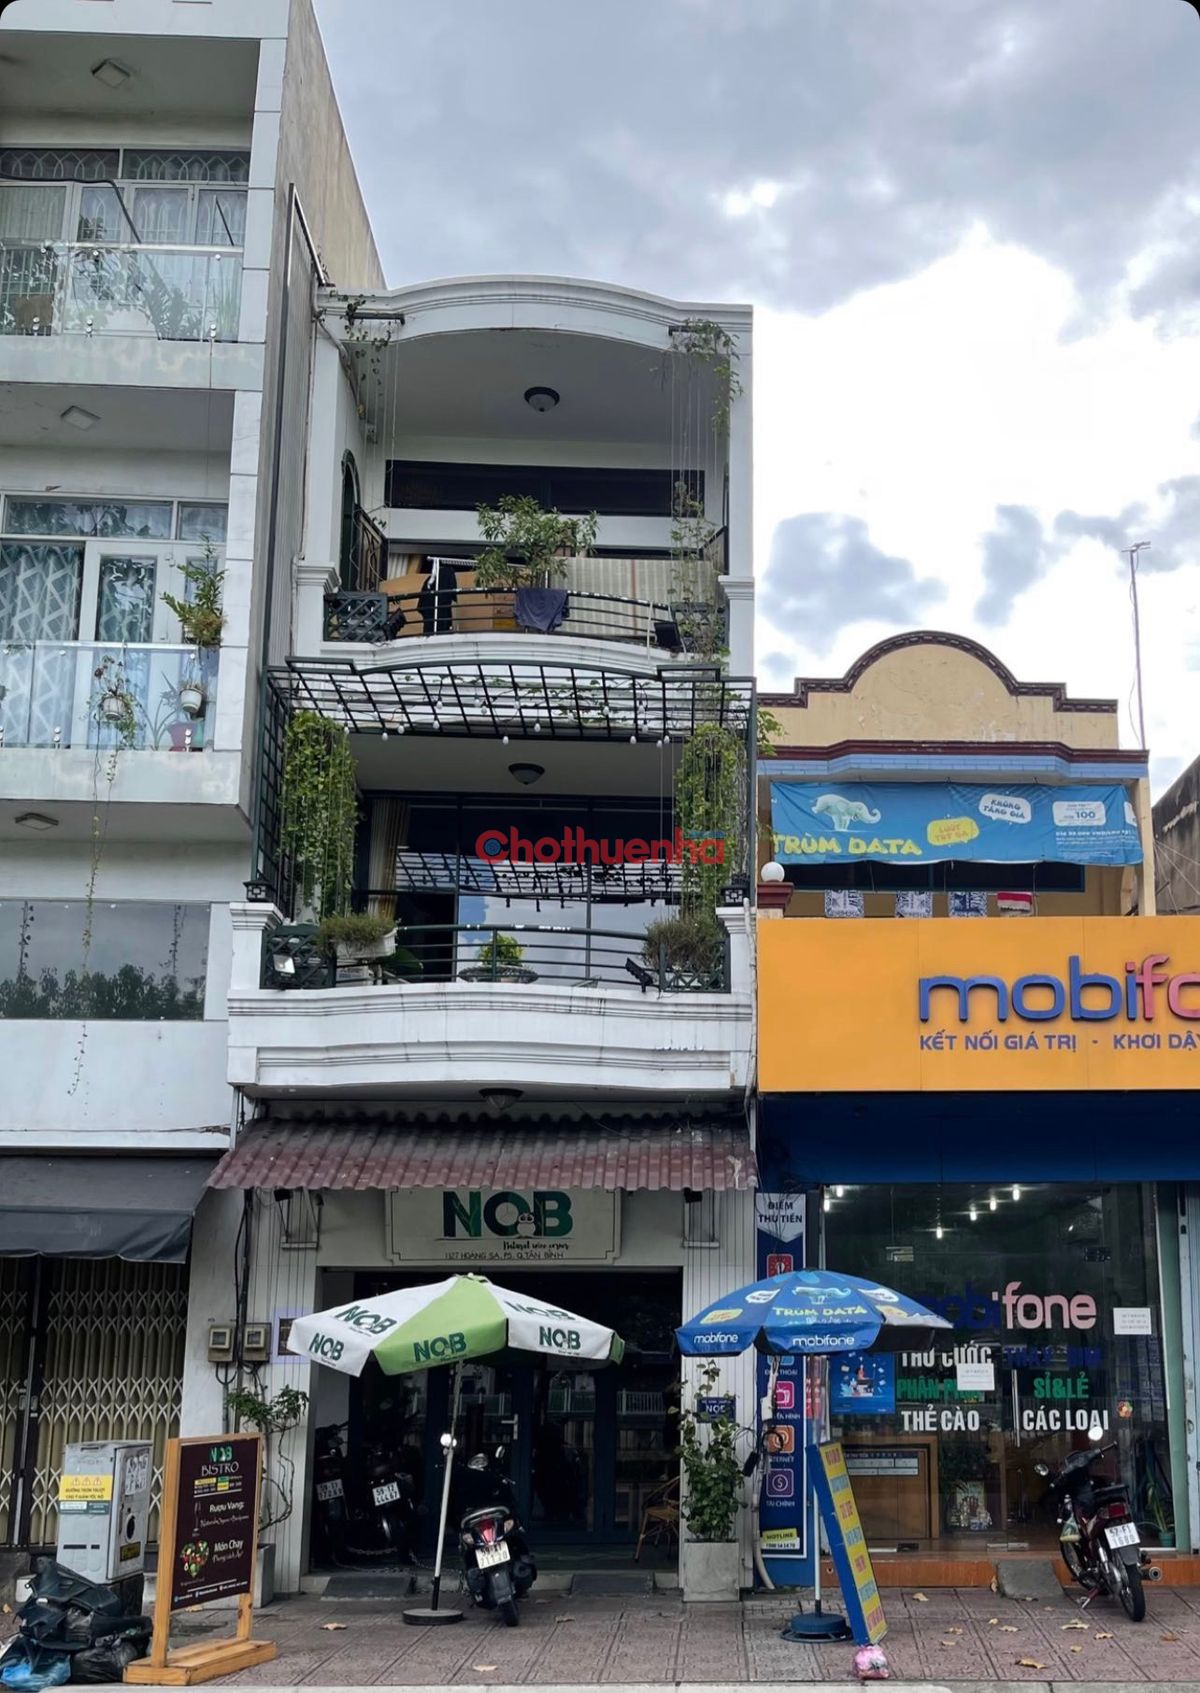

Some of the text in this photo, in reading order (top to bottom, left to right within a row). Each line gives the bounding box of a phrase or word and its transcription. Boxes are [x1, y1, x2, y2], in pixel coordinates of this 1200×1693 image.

[1075, 811, 1096, 820] 100
[773, 832, 922, 856] TRÙM DATA
[920, 1029, 957, 1050] KẾT
[965, 1031, 998, 1050] NỐI
[1004, 1031, 1039, 1050] GIÁ
[1044, 1034, 1077, 1053] TRỊ
[1113, 1034, 1161, 1050] KHƠI
[443, 1191, 573, 1237] NOB
[334, 1305, 398, 1335] NOB
[822, 1305, 868, 1316] DATA
[309, 1332, 345, 1361] NOB
[413, 1332, 468, 1363] NOB
[540, 1325, 581, 1350] NOB
[694, 1331, 739, 1345] mobifone
[792, 1334, 855, 1347] mobifone
[901, 1403, 980, 1432] THẺ CÀO
[1022, 1405, 1062, 1431] CÁC
[201, 1461, 239, 1476] BISTRO
